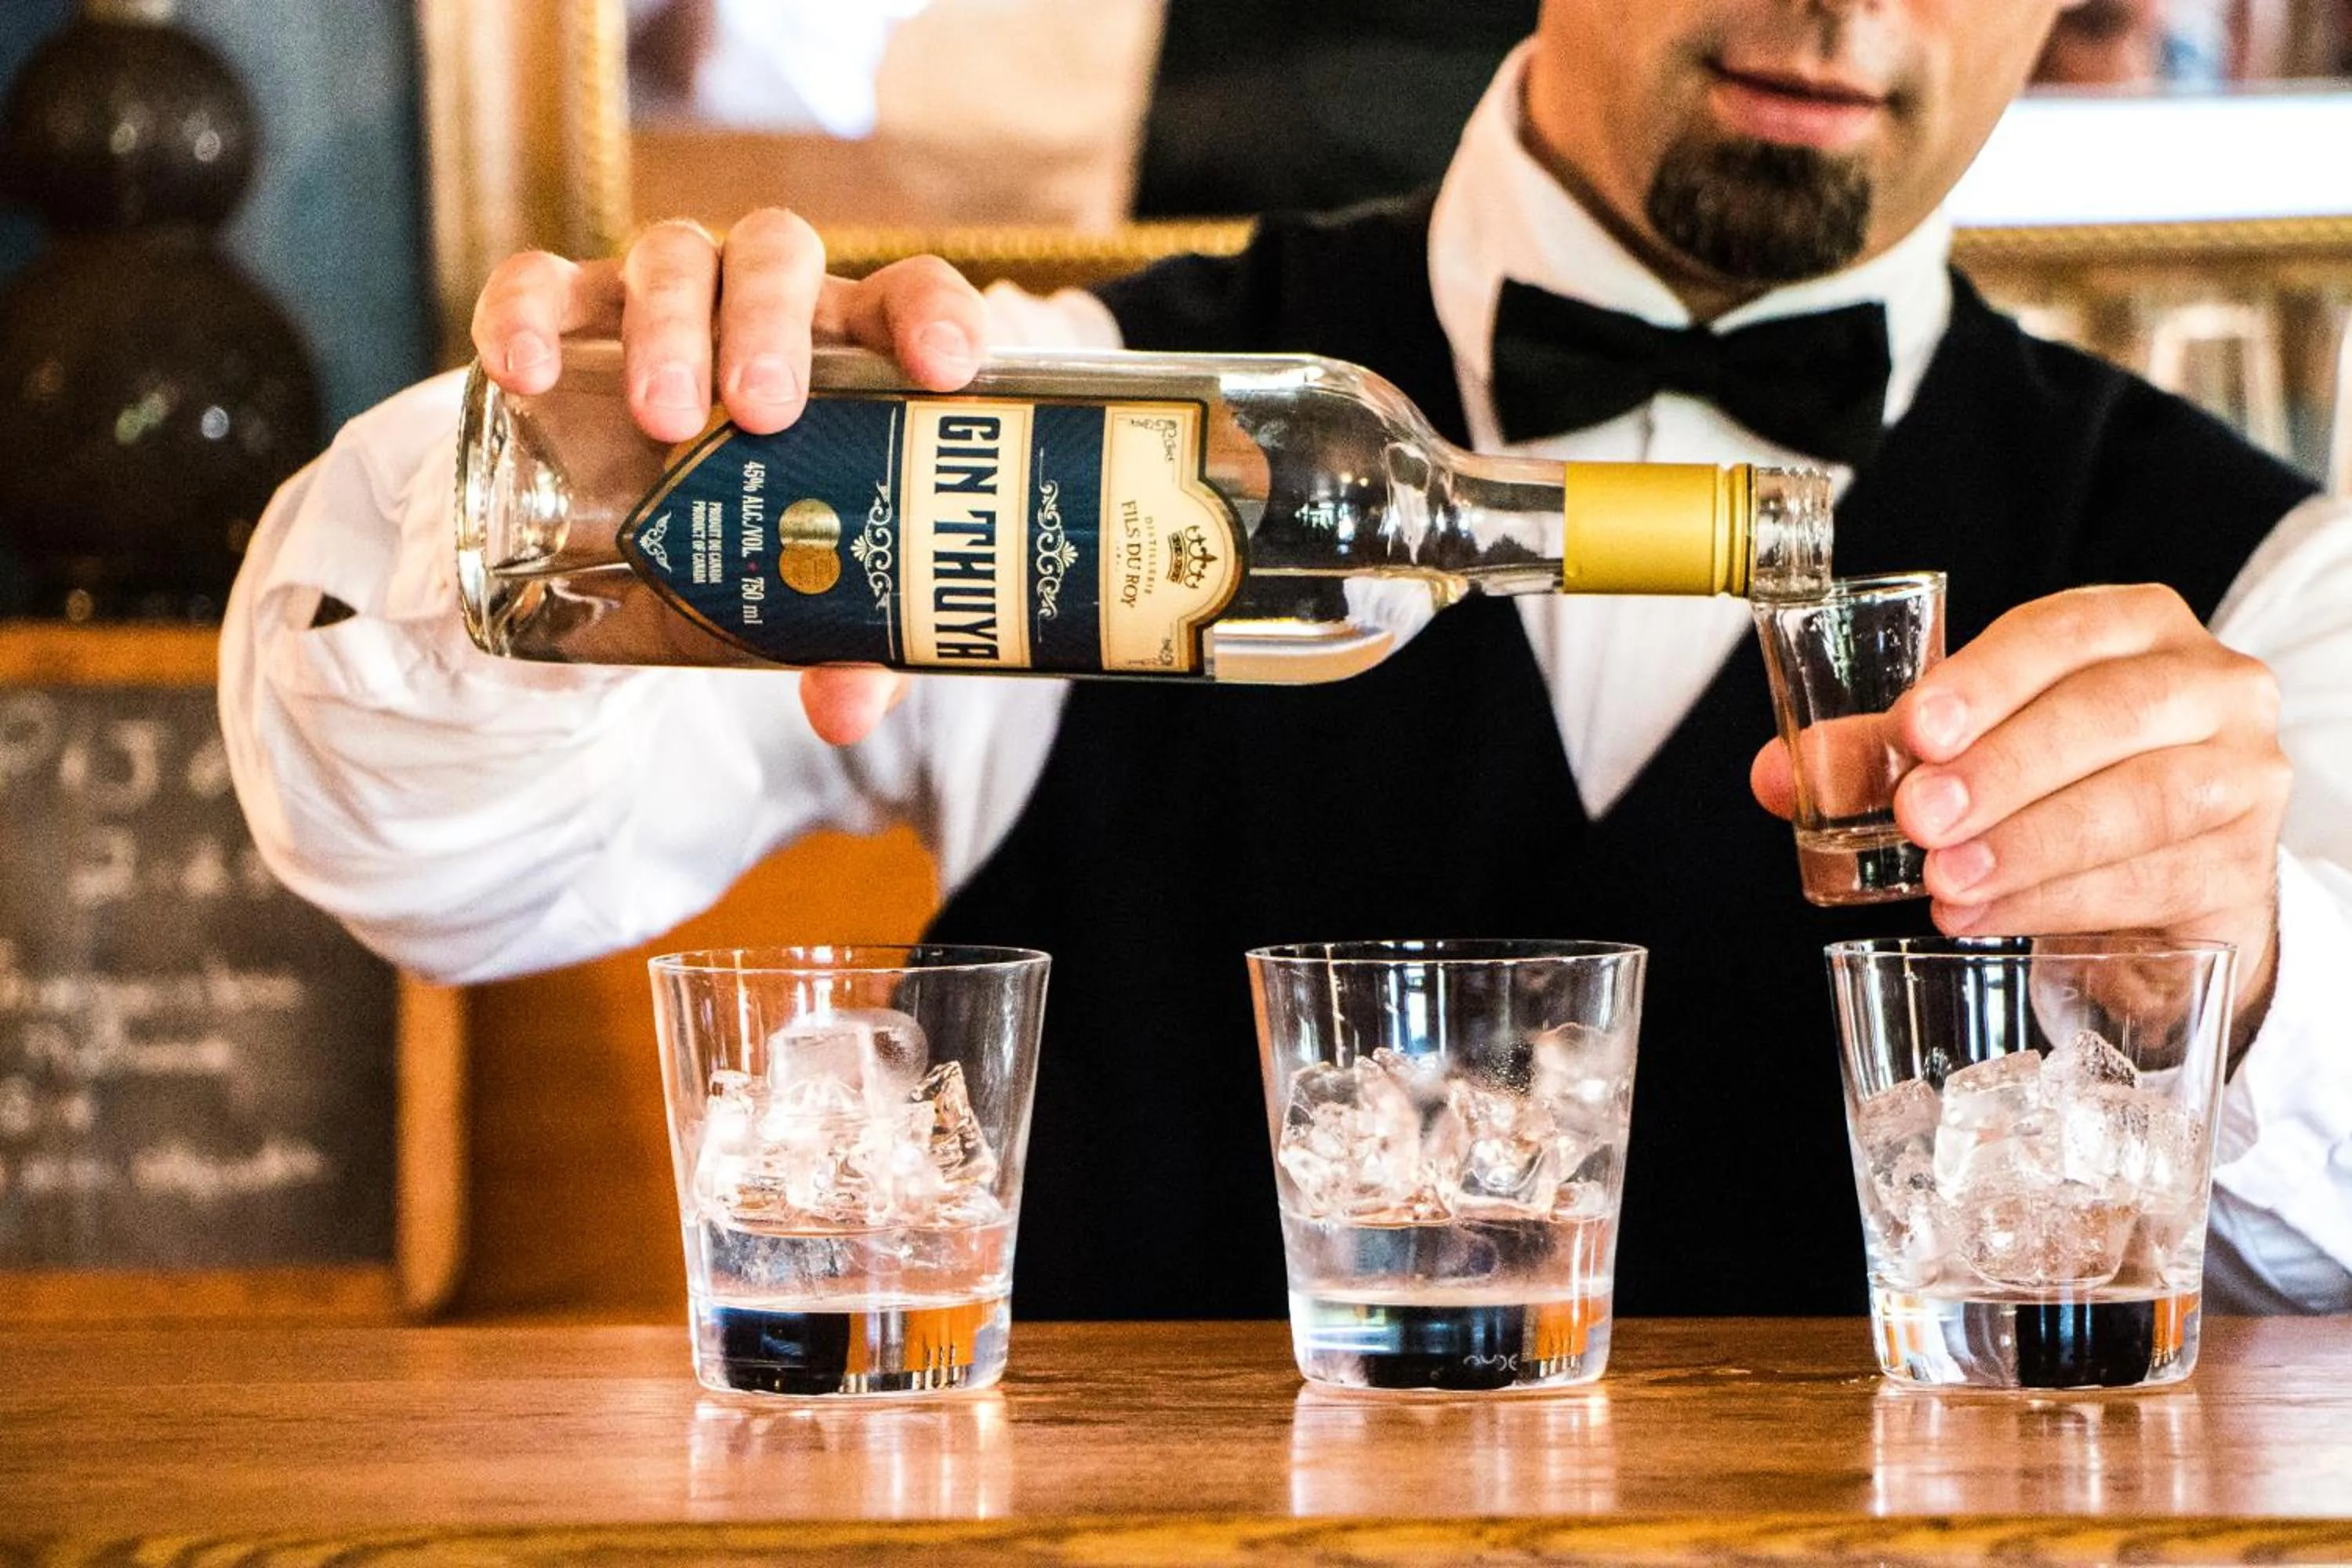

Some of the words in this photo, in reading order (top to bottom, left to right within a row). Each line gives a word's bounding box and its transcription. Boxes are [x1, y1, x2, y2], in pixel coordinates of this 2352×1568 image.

[934, 416, 1001, 495] GIN
[742, 460, 766, 492] 45%
[692, 501, 706, 539] PRODUCT
[1120, 499, 1141, 539] FILS
[692, 539, 706, 552] OF
[1126, 542, 1142, 571] DU
[1144, 515, 1157, 595] DISTILLERIE
[692, 552, 706, 583] CANADA
[708, 552, 722, 584] CANADA
[741, 576, 765, 601] 750
[933, 510, 1000, 661] THUYA
[1120, 573, 1141, 609] ROY
[742, 604, 764, 625] ml
